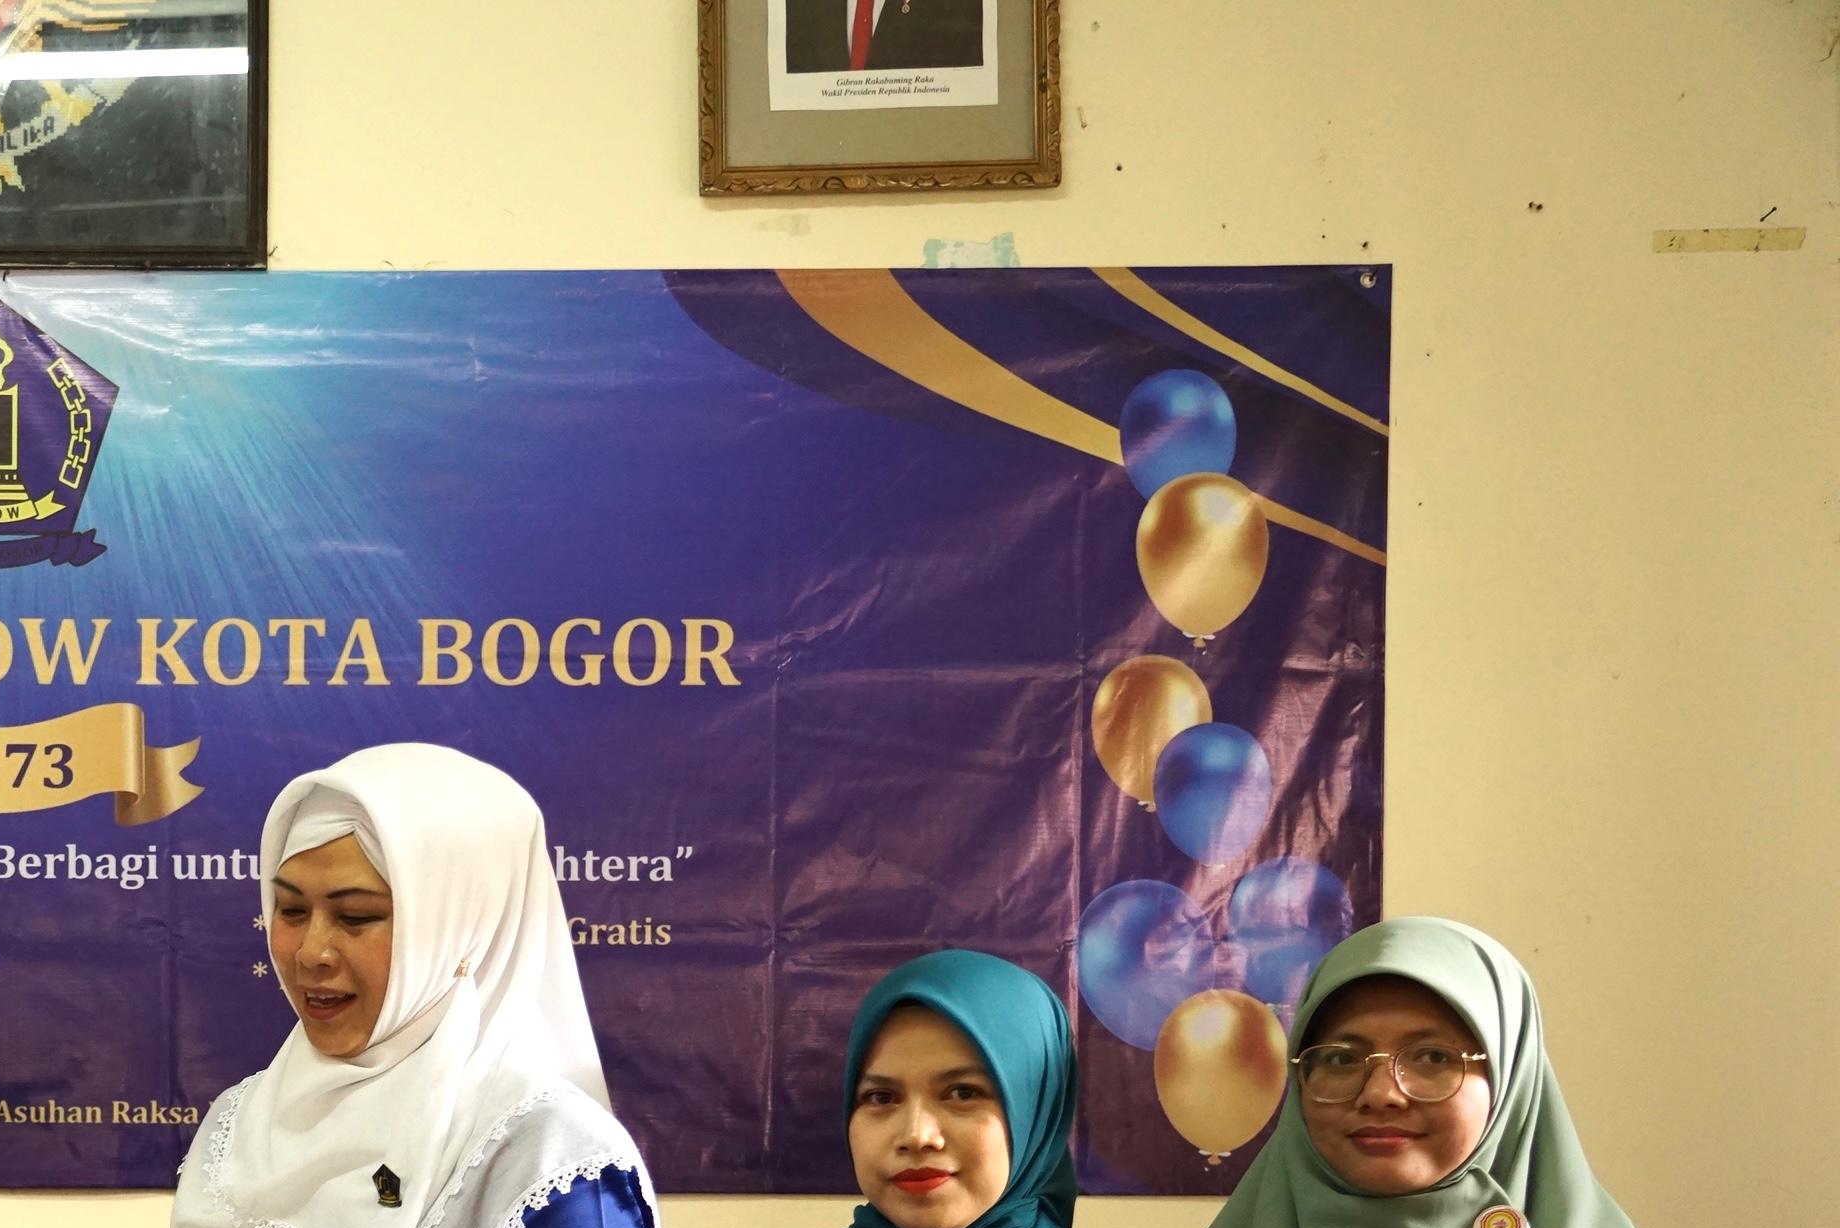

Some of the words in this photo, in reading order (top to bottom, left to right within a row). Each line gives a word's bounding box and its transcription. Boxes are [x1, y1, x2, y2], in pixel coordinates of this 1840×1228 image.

[821, 88, 843, 97] Wakil
[844, 87, 877, 97] Presiden
[878, 86, 911, 97] Republik
[913, 85, 951, 95] Indonesia
[836, 78, 863, 87] Gibran
[865, 76, 913, 86] Rakabuming
[914, 75, 935, 84] Raka
[135, 617, 391, 686] KOTA
[418, 617, 742, 687] BOGOR
[4, 744, 74, 789] 73
[171, 848, 262, 881] untu
[553, 845, 694, 882] htera”
[568, 916, 672, 946] Gratis
[111, 1099, 199, 1124] Raksa
